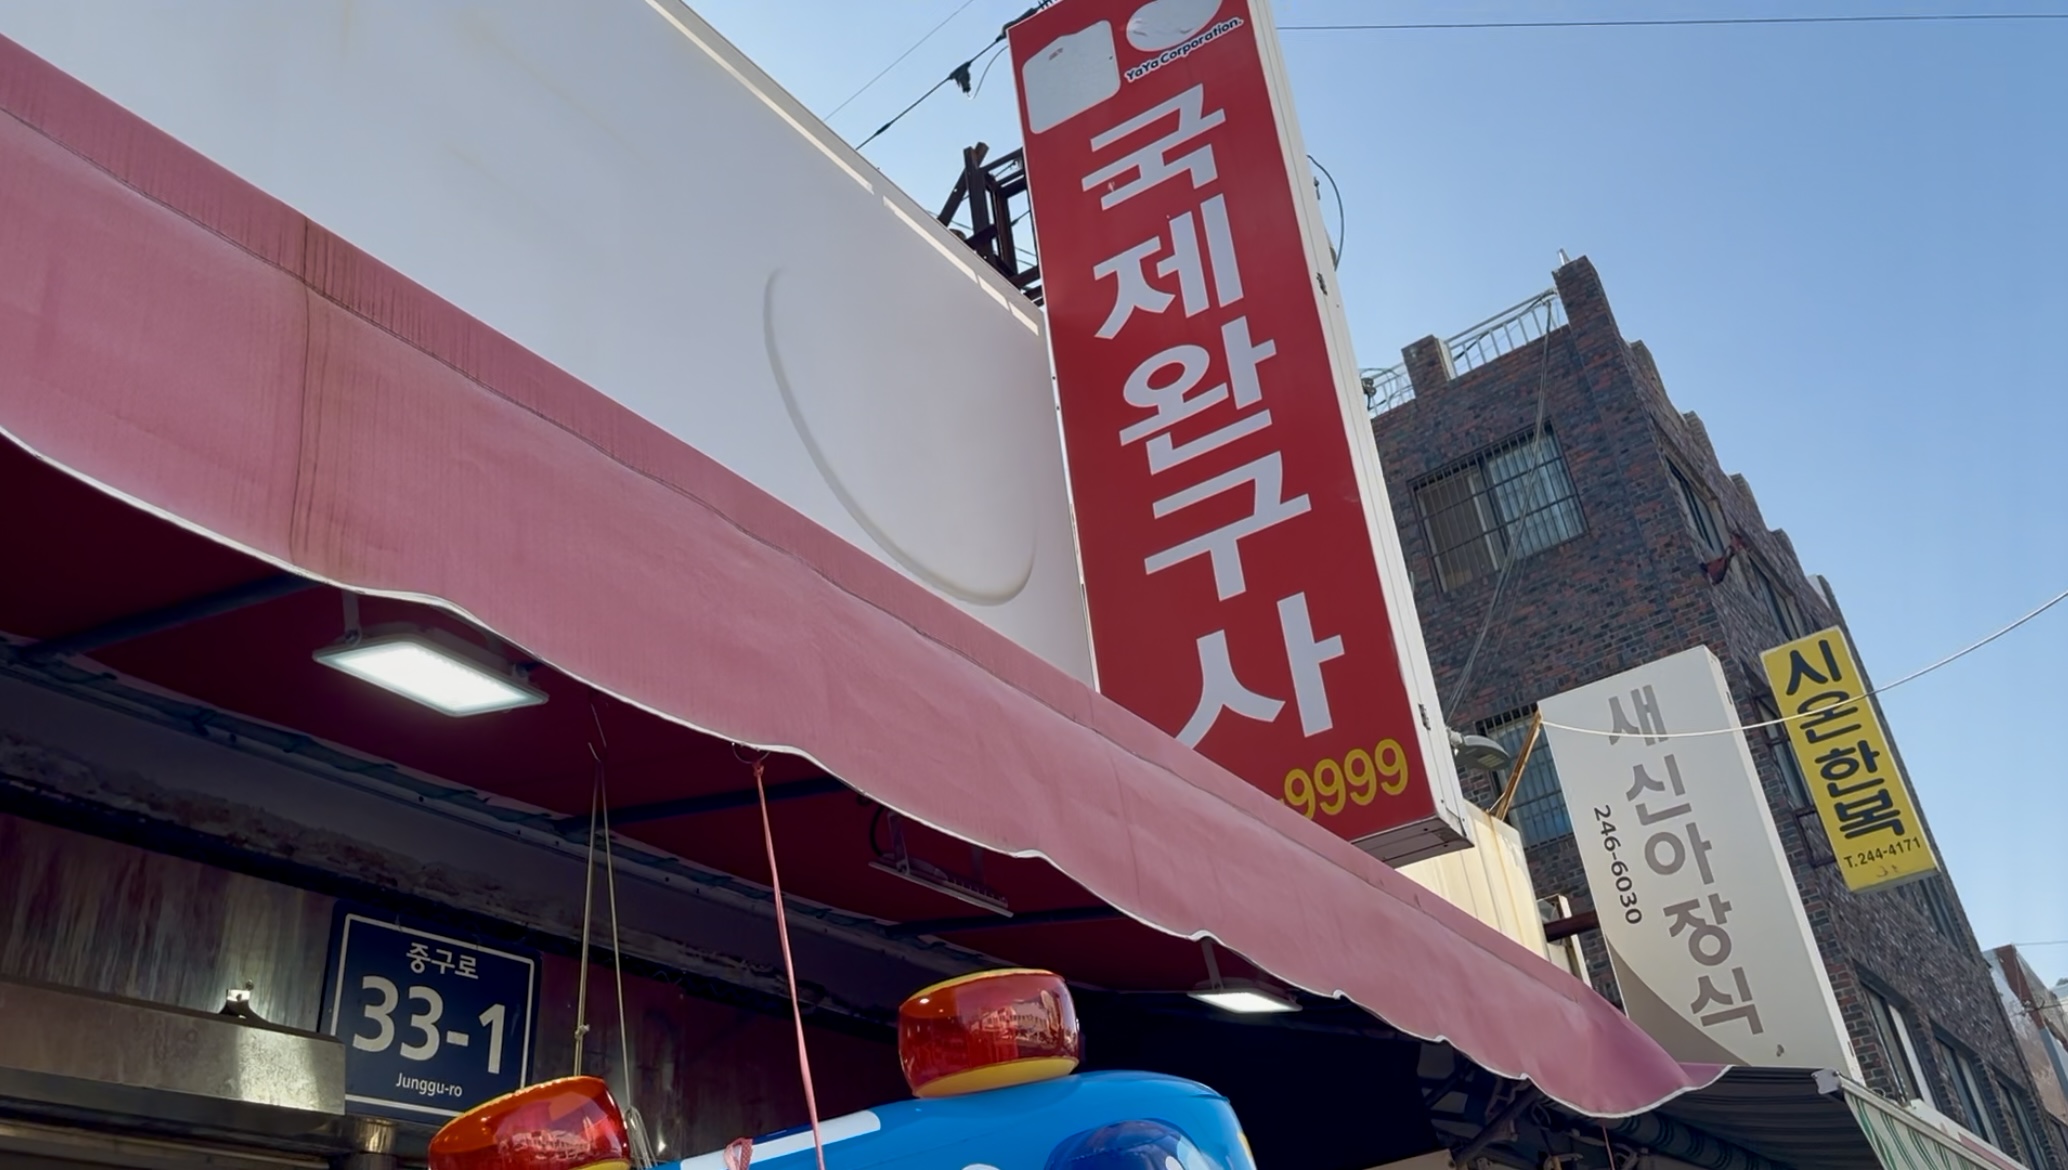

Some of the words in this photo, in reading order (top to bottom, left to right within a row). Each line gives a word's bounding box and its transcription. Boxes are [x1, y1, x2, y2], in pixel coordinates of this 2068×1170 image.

[1125, 58, 1159, 81] YaYa
[1081, 83, 1345, 749] 국제완구사
[1279, 738, 1409, 820] 9999
[1786, 639, 1905, 840] 시온한복
[1594, 804, 1642, 924] 246-6030
[1608, 684, 1764, 1036] 새신아장식
[406, 942, 479, 980] 중구로
[352, 975, 506, 1075] 33-1
[396, 1072, 463, 1098] Junggu-ro
